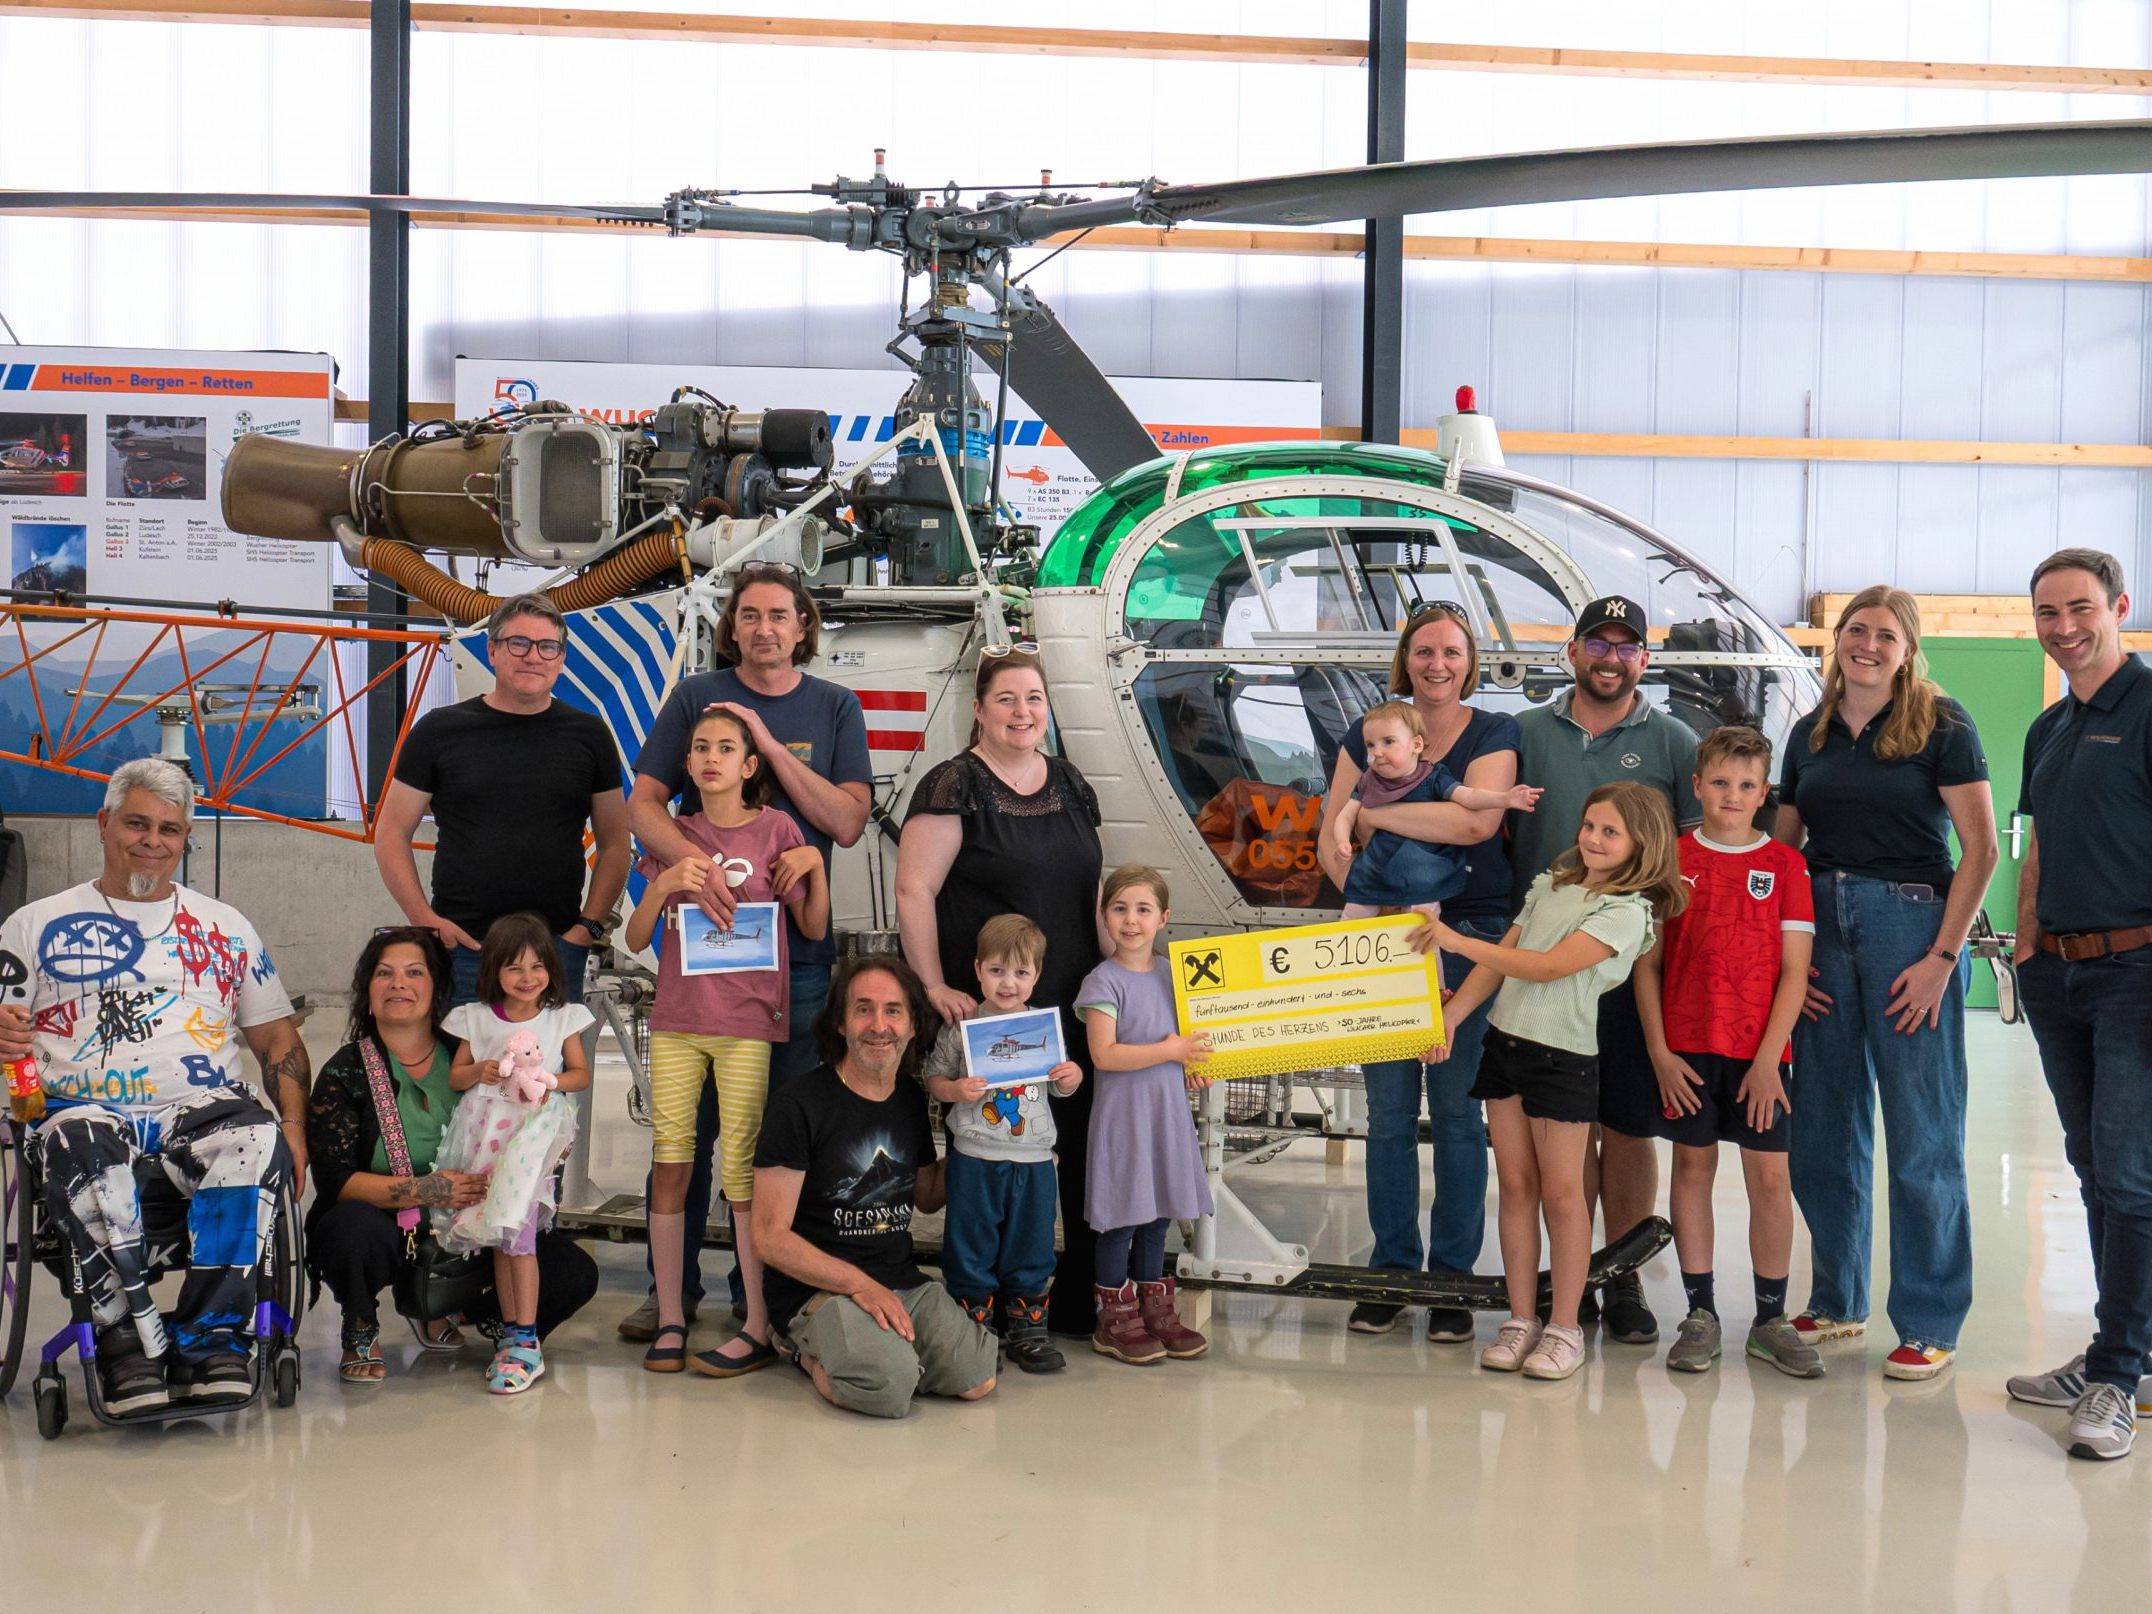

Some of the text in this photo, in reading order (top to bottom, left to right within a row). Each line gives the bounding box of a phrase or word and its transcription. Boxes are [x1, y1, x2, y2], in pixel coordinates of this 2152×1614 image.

[61, 372, 112, 385] Helfen
[129, 373, 185, 390] Bergen
[202, 376, 254, 389] Retten
[1161, 431, 1209, 444] Zahlen
[1250, 794, 1324, 833] W
[1269, 946, 1291, 974] €
[1314, 991, 1333, 1000] und
[1341, 987, 1367, 998] sechs
[1252, 1026, 1276, 1039] DES
[1280, 1021, 1330, 1037] HERZENS
